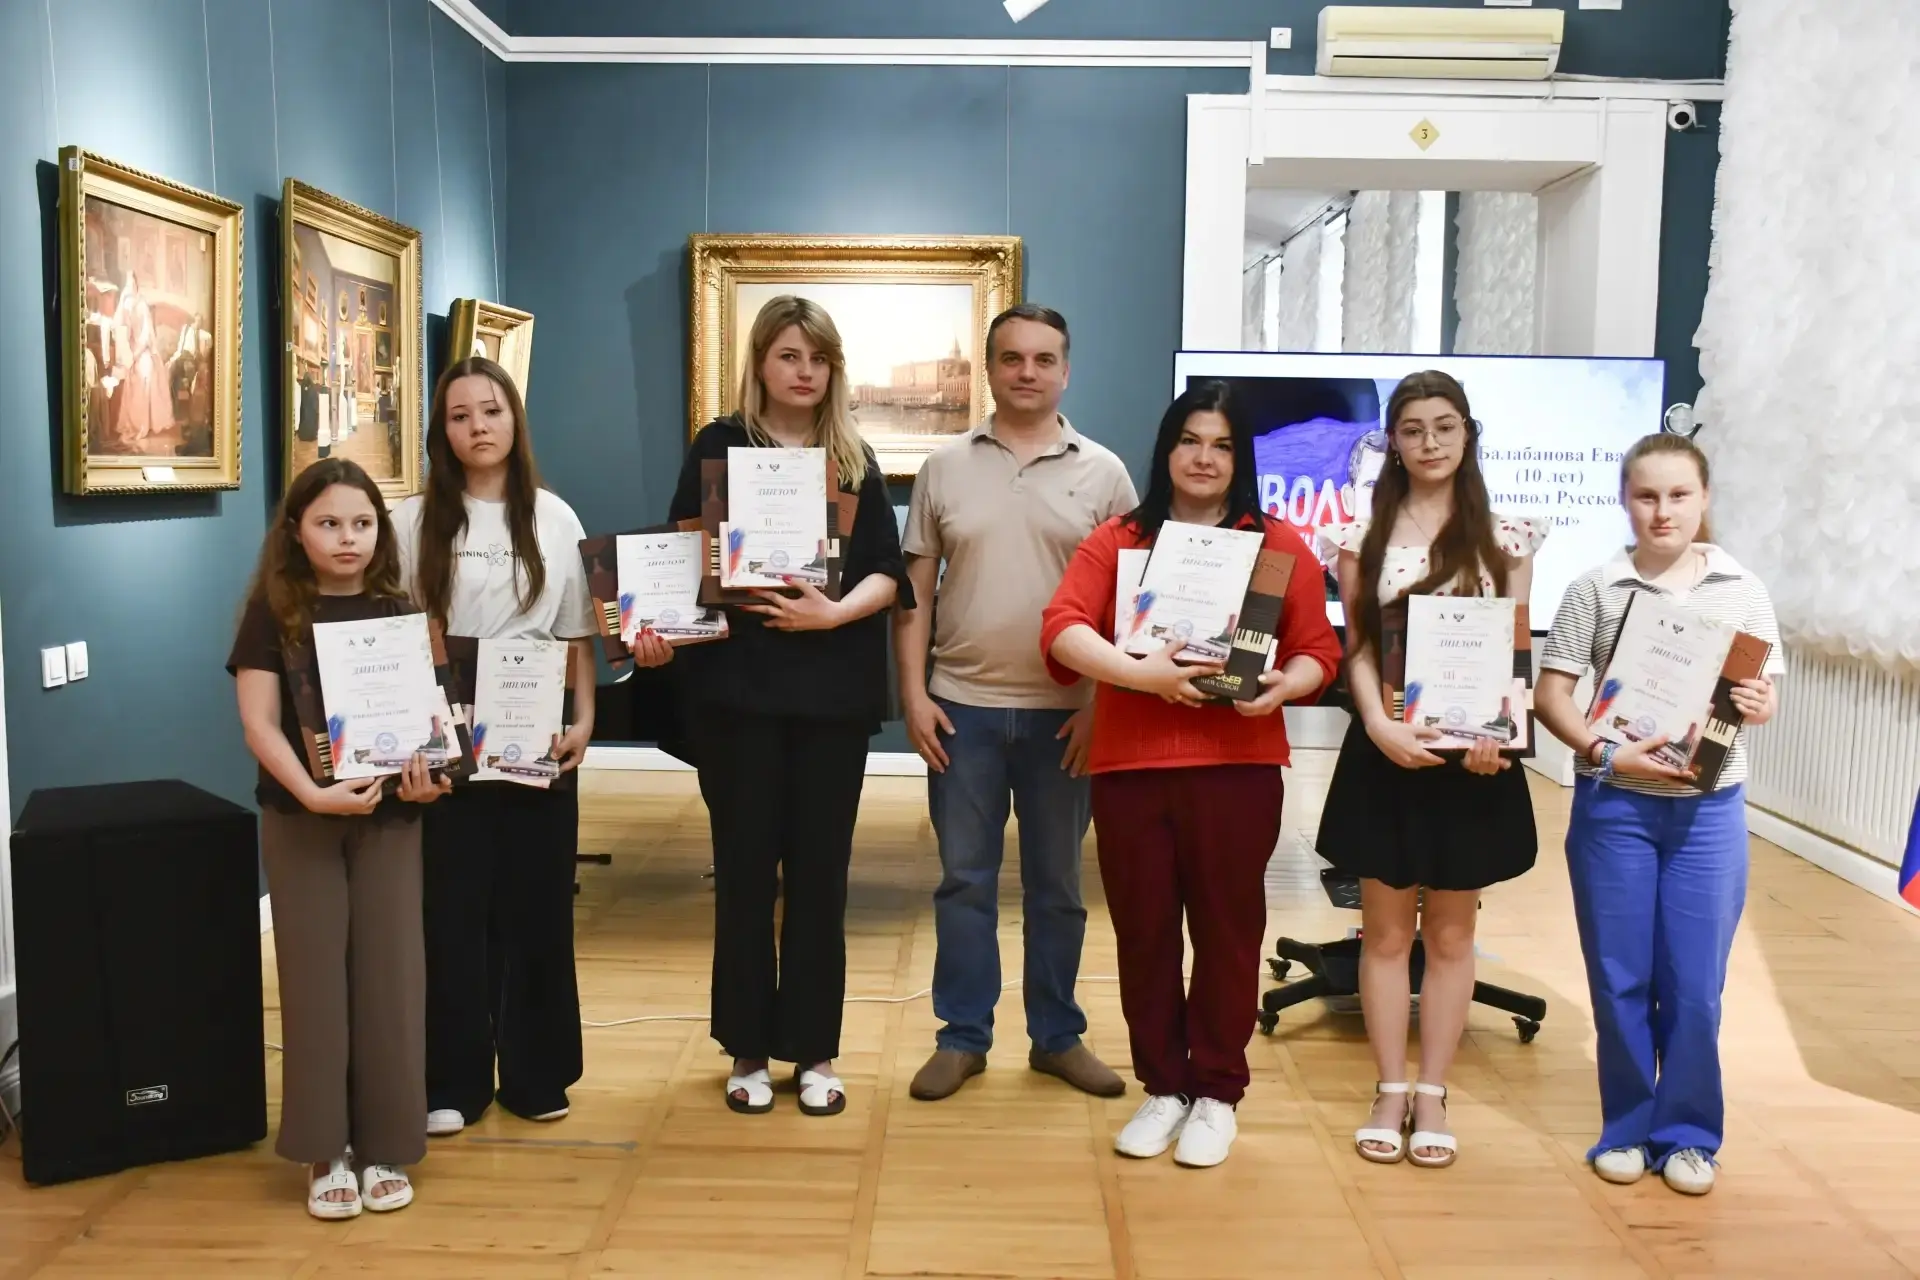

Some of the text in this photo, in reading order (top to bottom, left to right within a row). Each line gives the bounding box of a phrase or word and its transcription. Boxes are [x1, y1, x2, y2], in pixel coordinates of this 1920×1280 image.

[1421, 128, 1428, 140] 3
[1479, 445, 1624, 462] Балабанова Ева
[1515, 468, 1584, 485] (10 лет)
[756, 488, 798, 497] ДИПЛОМ
[455, 550, 490, 559] HINING
[1435, 639, 1484, 649] ДИПЛОМ
[1645, 645, 1693, 667] ДИПЛОМ
[352, 661, 400, 676] ДИПЛОМ
[499, 681, 538, 690] ДИПЛОМ
